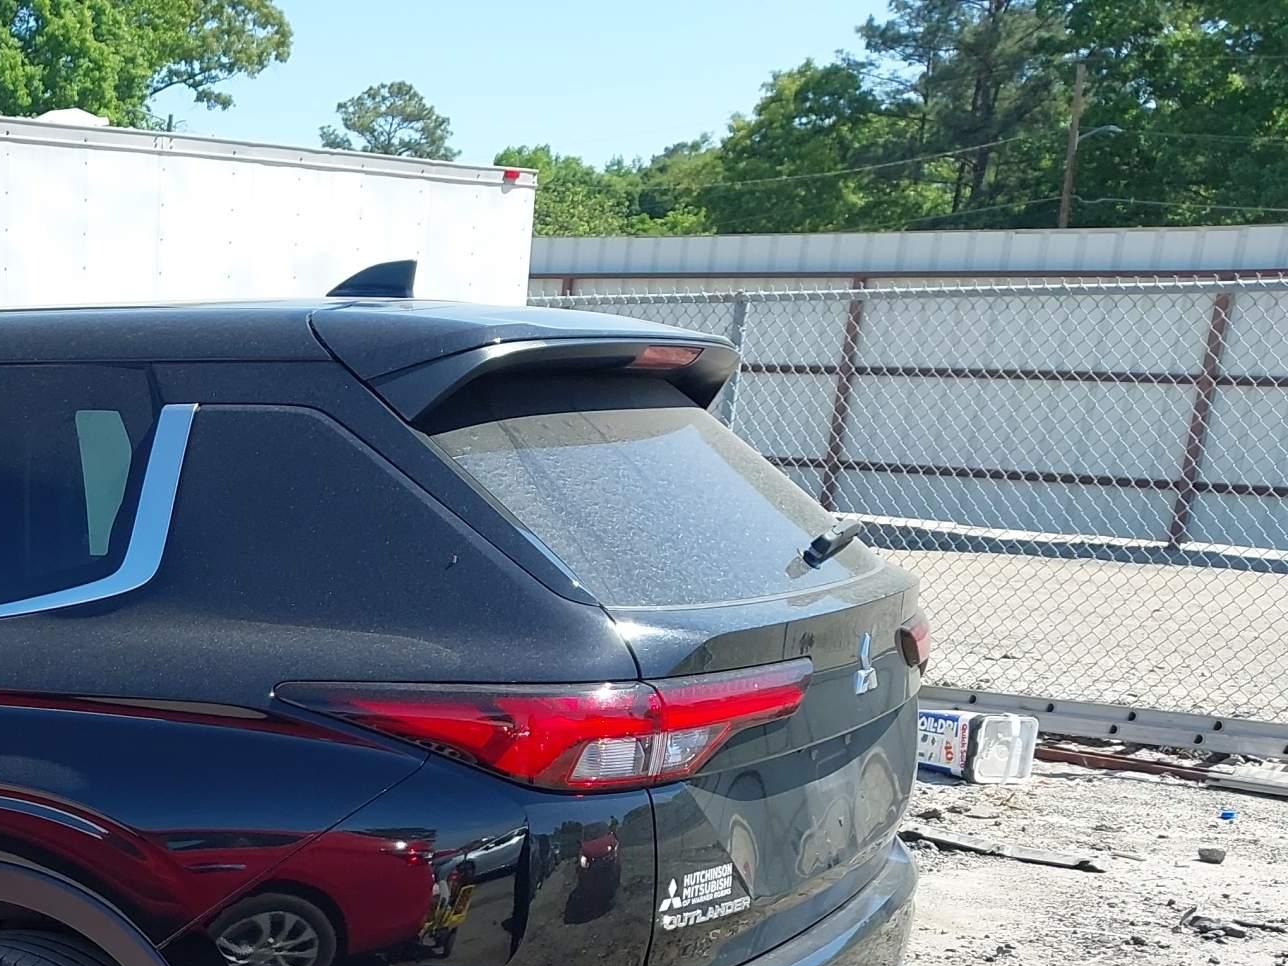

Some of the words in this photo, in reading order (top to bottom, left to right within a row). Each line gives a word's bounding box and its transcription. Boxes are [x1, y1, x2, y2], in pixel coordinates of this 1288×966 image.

[683, 862, 733, 887] HUTCHINSON
[682, 875, 732, 900] MITSUBISHI
[663, 896, 751, 931] OUTLANDER
